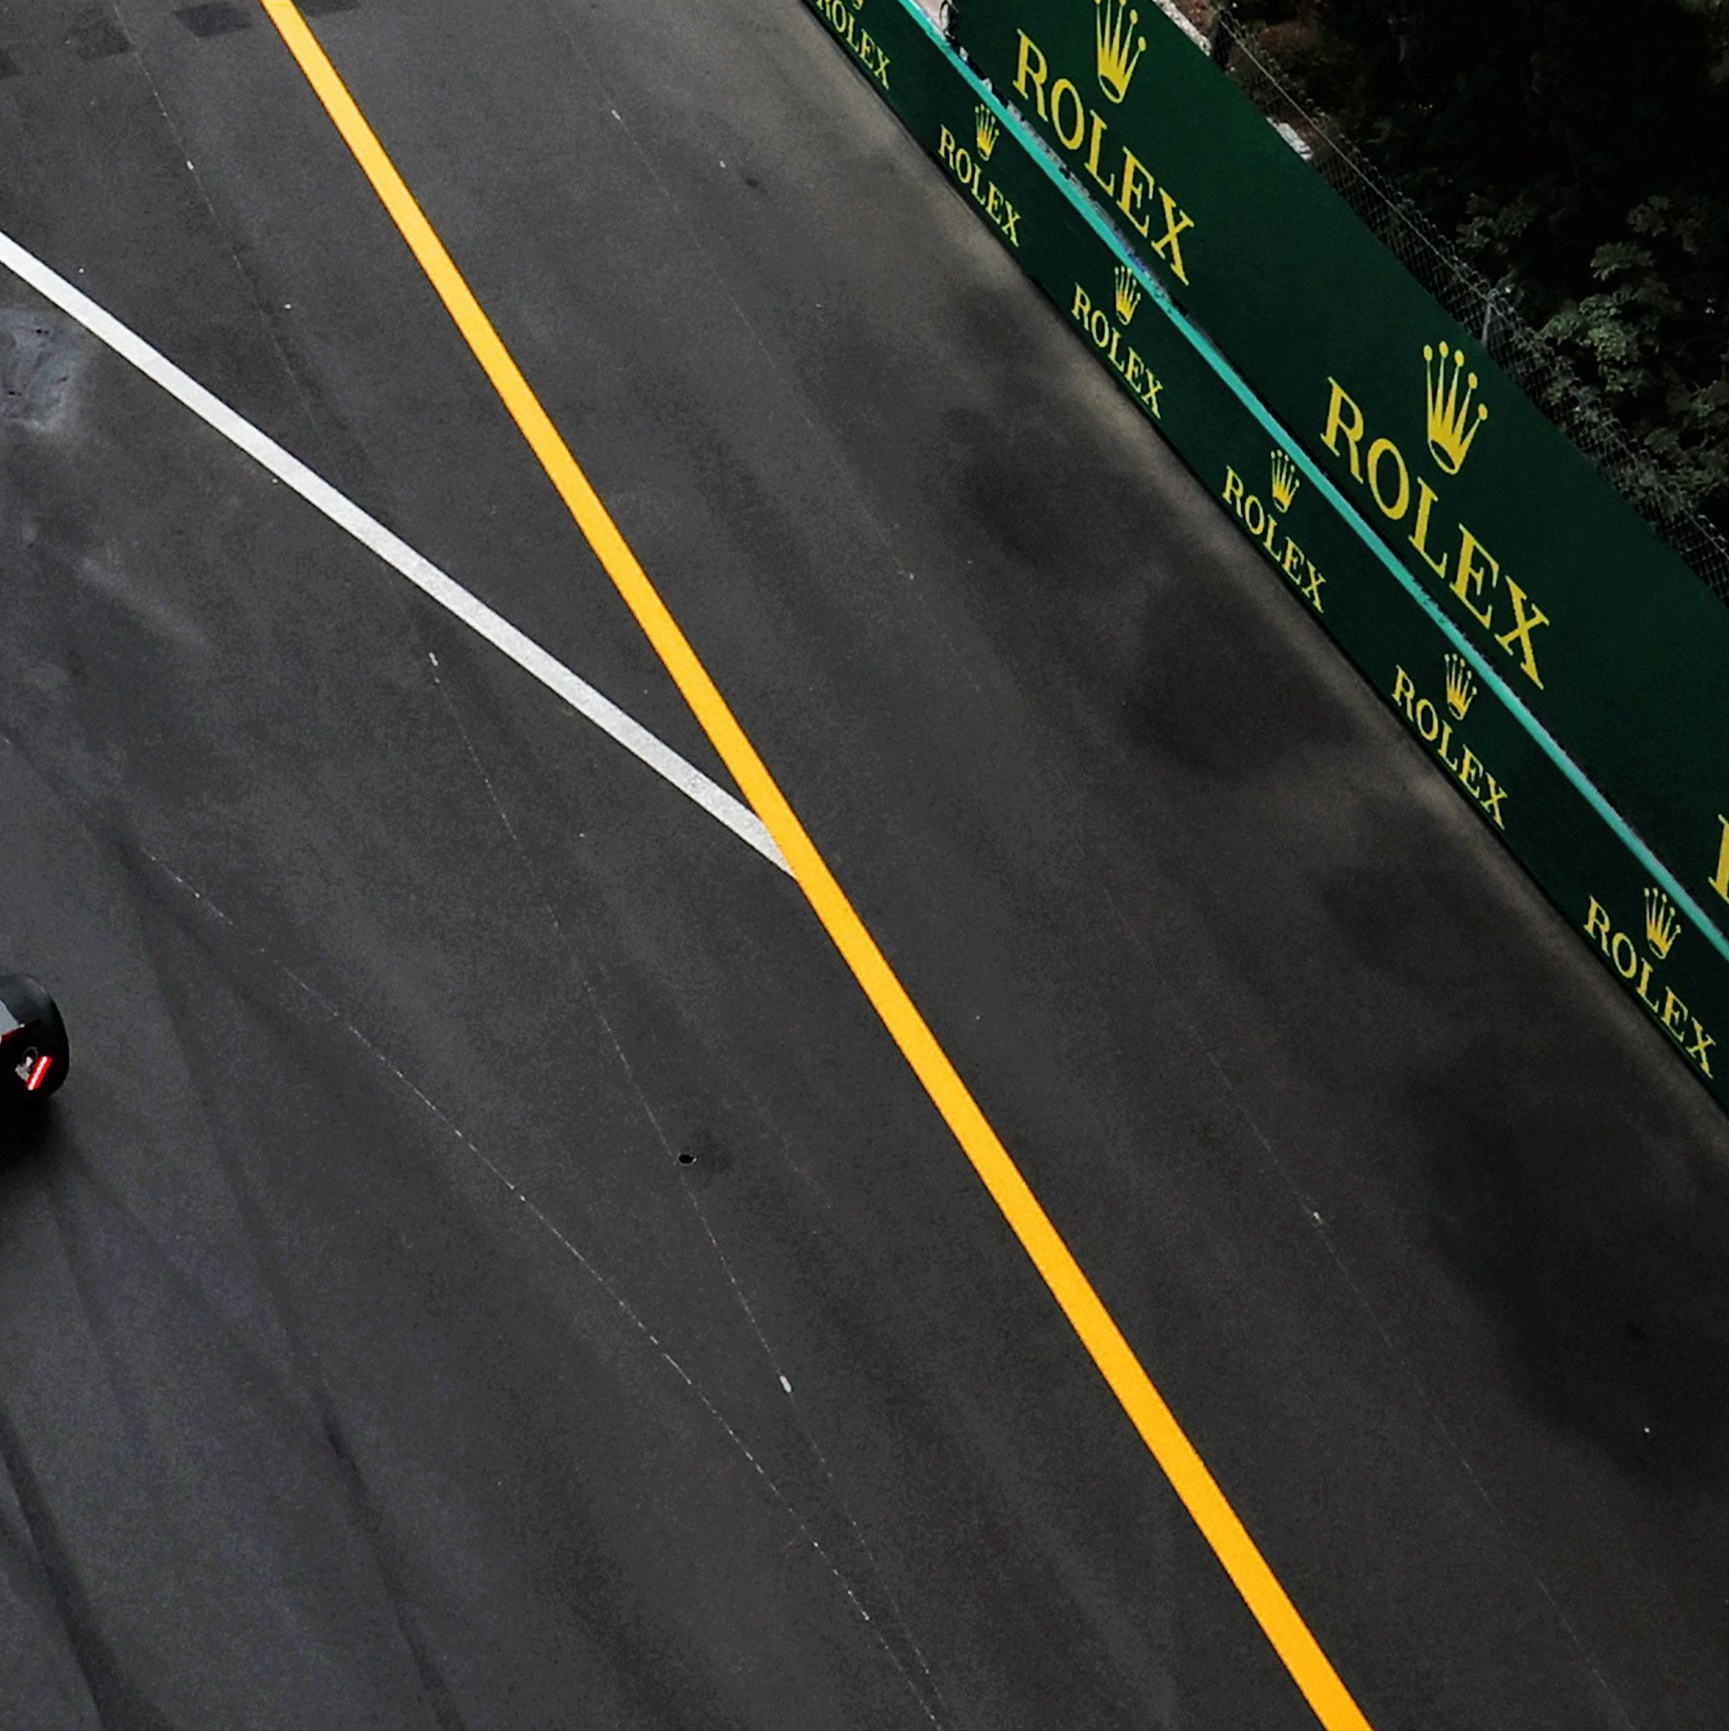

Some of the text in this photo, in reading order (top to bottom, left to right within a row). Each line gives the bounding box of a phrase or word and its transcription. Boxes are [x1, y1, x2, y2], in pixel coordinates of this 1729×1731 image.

[939, 123, 1020, 248] ROLEX
[1012, 28, 1195, 287] ROLEX
[1072, 282, 1164, 419] ROLEX
[1222, 466, 1327, 614] ROLEX
[1320, 376, 1550, 691] ROLEX
[1390, 664, 1509, 830] ROLEX
[1583, 896, 1717, 1079] ROLEX
